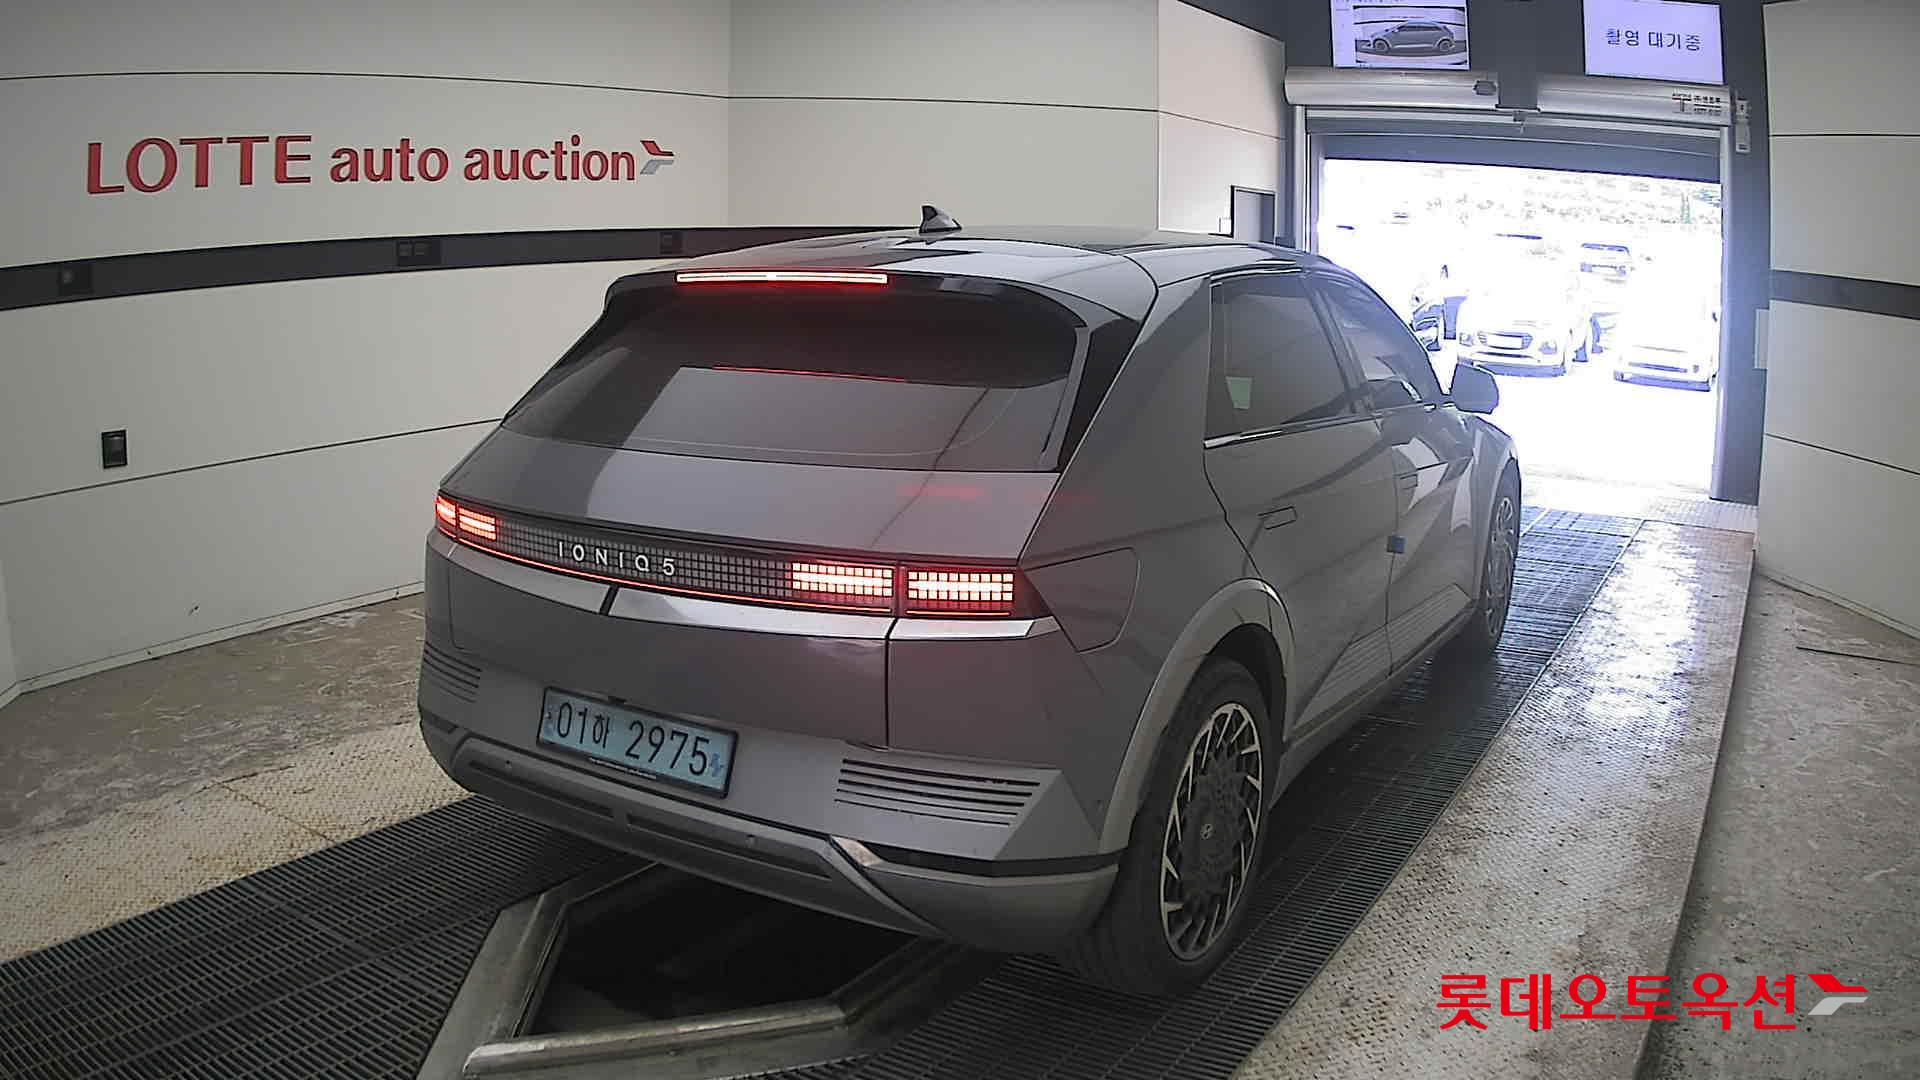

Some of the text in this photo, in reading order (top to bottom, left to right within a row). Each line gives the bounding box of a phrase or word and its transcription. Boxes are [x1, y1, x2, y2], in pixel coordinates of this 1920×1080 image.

[87, 134, 636, 195] LOTTE auto auction
[625, 720, 710, 776] 2975
